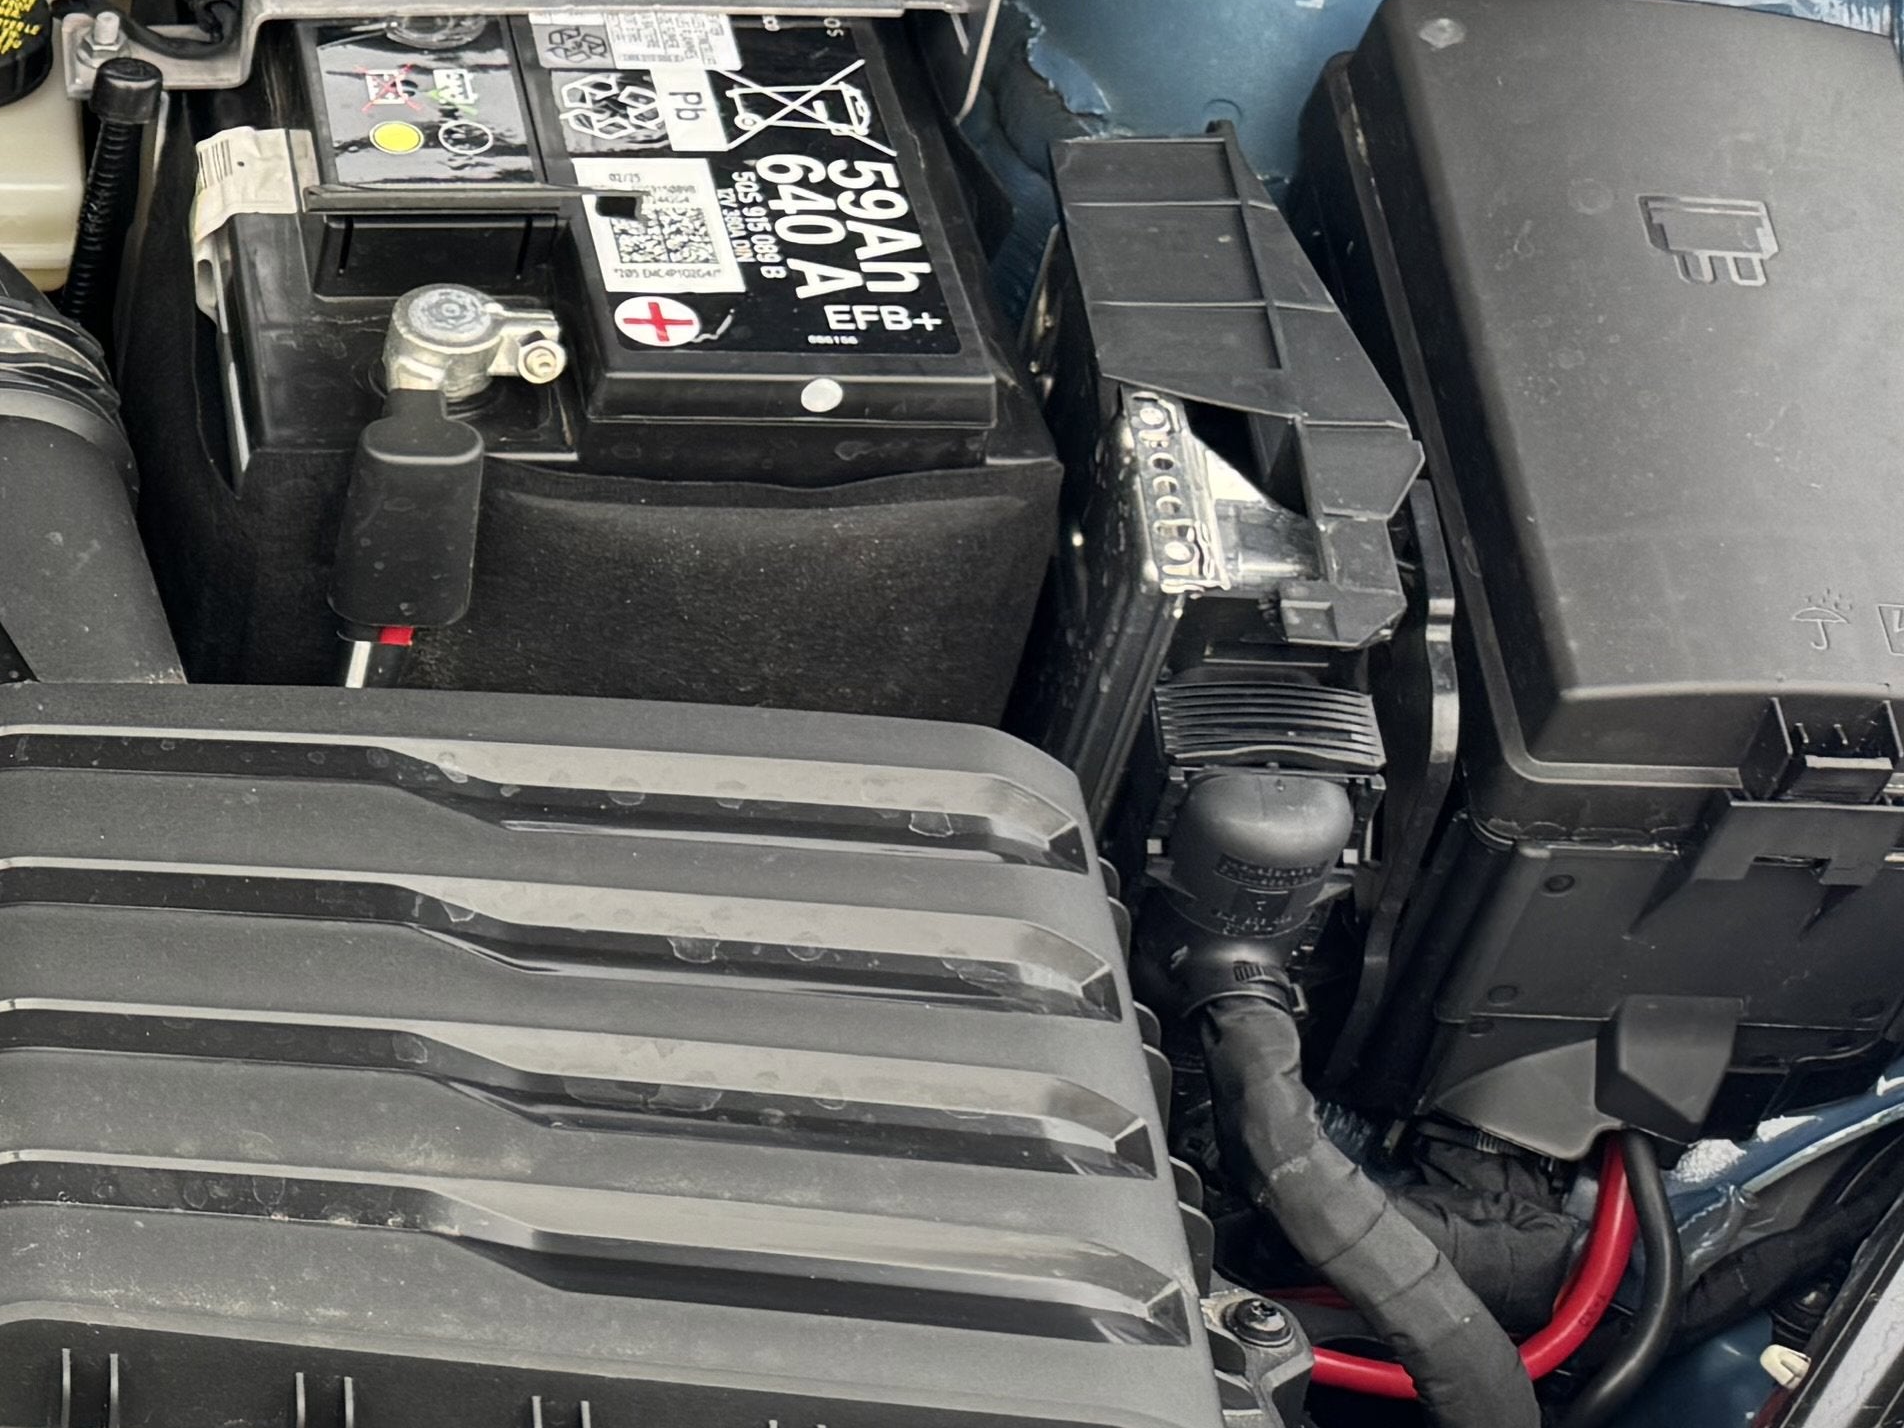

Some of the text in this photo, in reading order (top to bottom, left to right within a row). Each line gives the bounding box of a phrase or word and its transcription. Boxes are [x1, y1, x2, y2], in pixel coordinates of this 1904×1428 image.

[669, 91, 706, 122] Pb
[755, 153, 848, 245] 640
[826, 158, 932, 293] 59Ah
[742, 205, 772, 233] 915
[760, 265, 788, 280] B
[786, 257, 865, 300] A
[823, 304, 943, 332] EFB+
